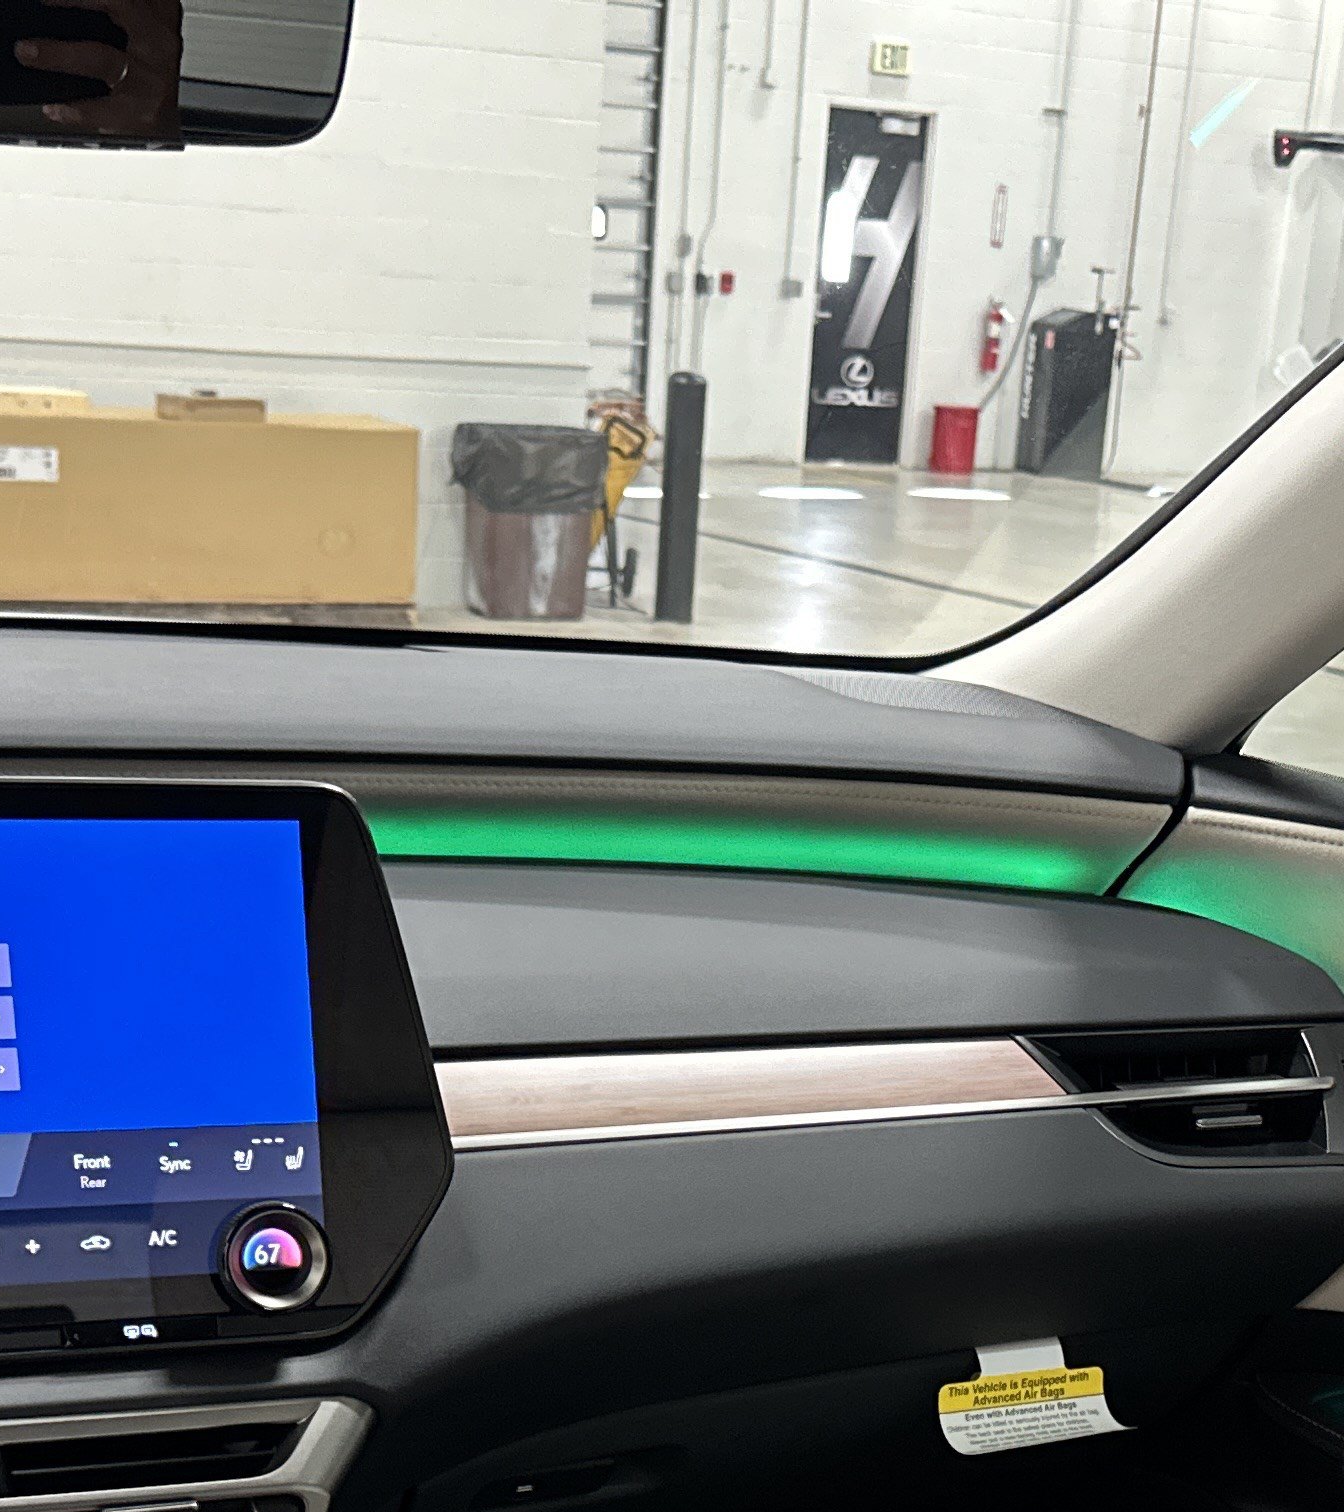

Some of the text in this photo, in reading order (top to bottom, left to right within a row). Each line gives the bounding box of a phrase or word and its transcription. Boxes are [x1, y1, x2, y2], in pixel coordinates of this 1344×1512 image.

[881, 44, 908, 70] EXIT
[812, 386, 898, 407] LEXUS
[73, 1154, 111, 1170] Front
[159, 1156, 191, 1173] Sync
[80, 1176, 106, 1188] Rear
[148, 1230, 177, 1246] A/C
[254, 1244, 281, 1264] 67
[948, 1372, 1089, 1398] This Vehicle is Equipped with
[973, 1387, 1065, 1406] Advanced Air Bags
[965, 1401, 1077, 1421] Even with Advanced Air Bags
